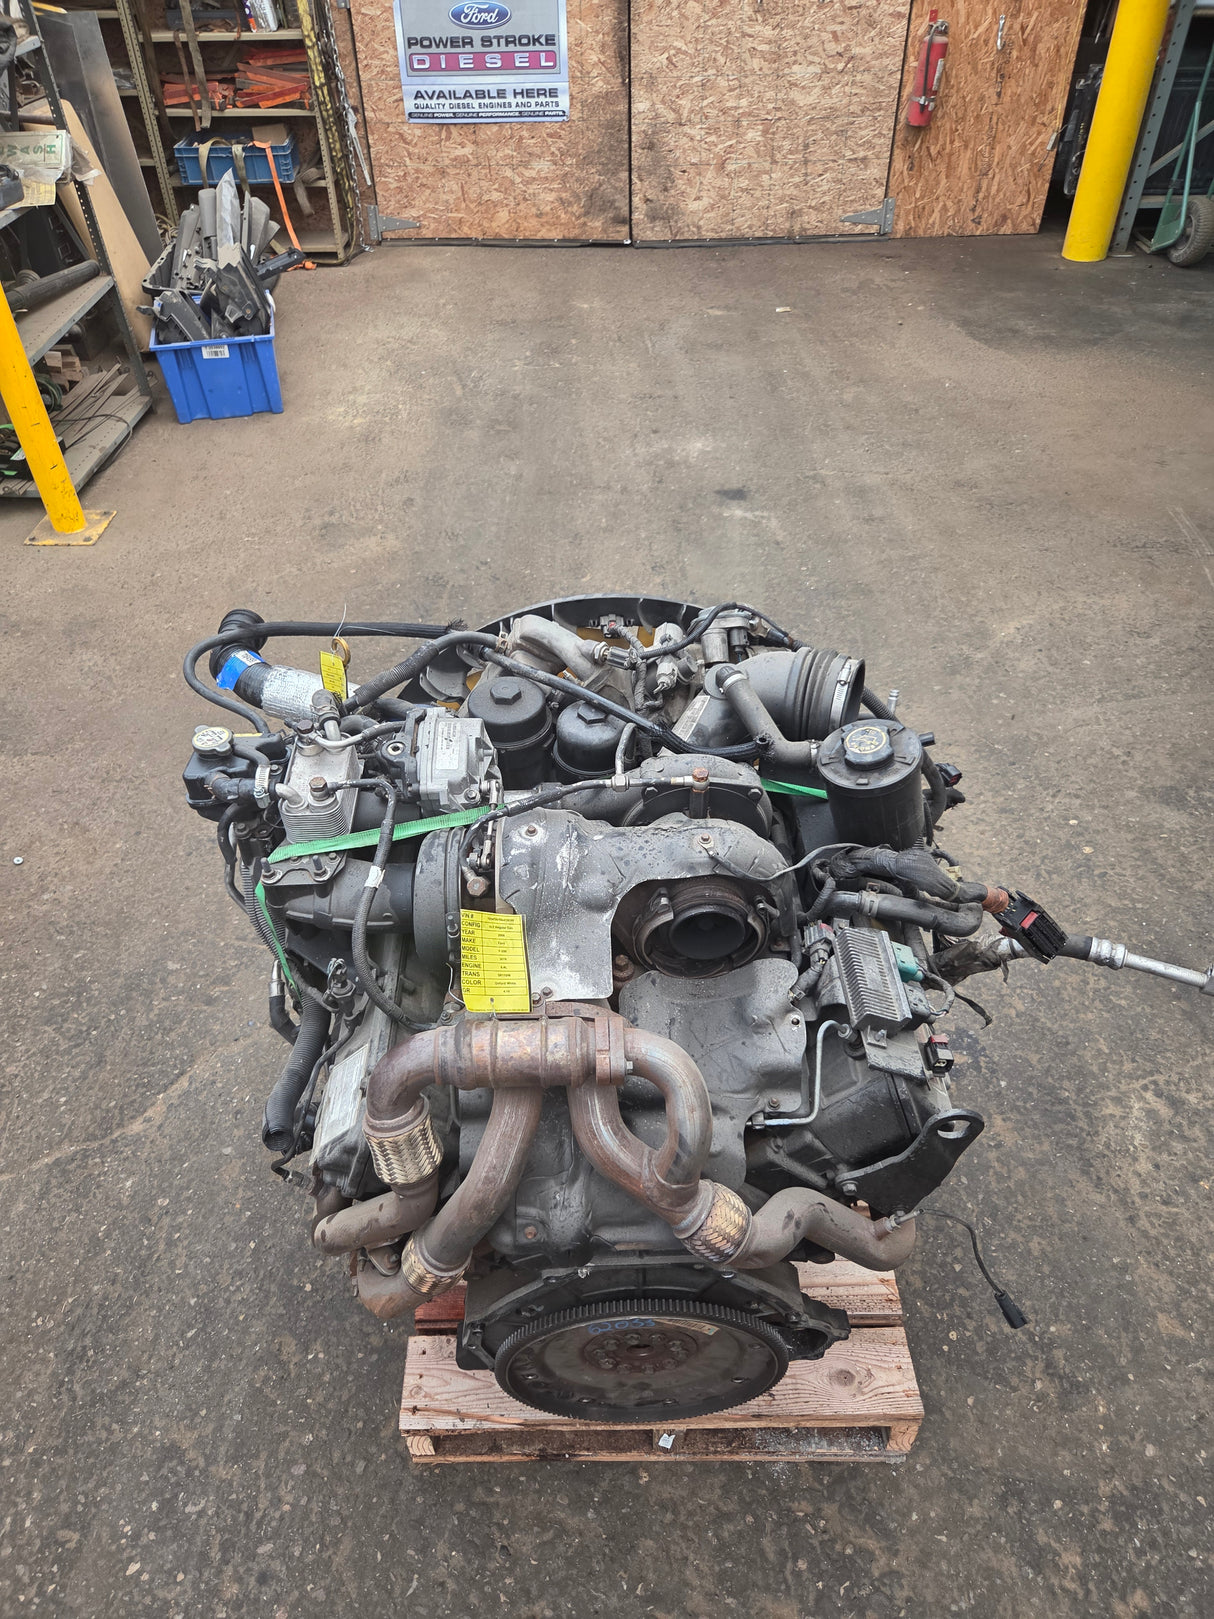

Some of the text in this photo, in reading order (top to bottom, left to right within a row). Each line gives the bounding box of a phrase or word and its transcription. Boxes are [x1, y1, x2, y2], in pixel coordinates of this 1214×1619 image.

[461, 3, 499, 23] Ford
[407, 34, 556, 49] POWER STROKE
[412, 53, 554, 69] DIESEL
[413, 88, 559, 101] AVAILABLE HERE
[414, 102, 446, 110] QUALITY
[478, 101, 512, 109] ENGINES
[462, 920, 481, 928] CONFIG
[462, 945, 480, 953] MODEL
